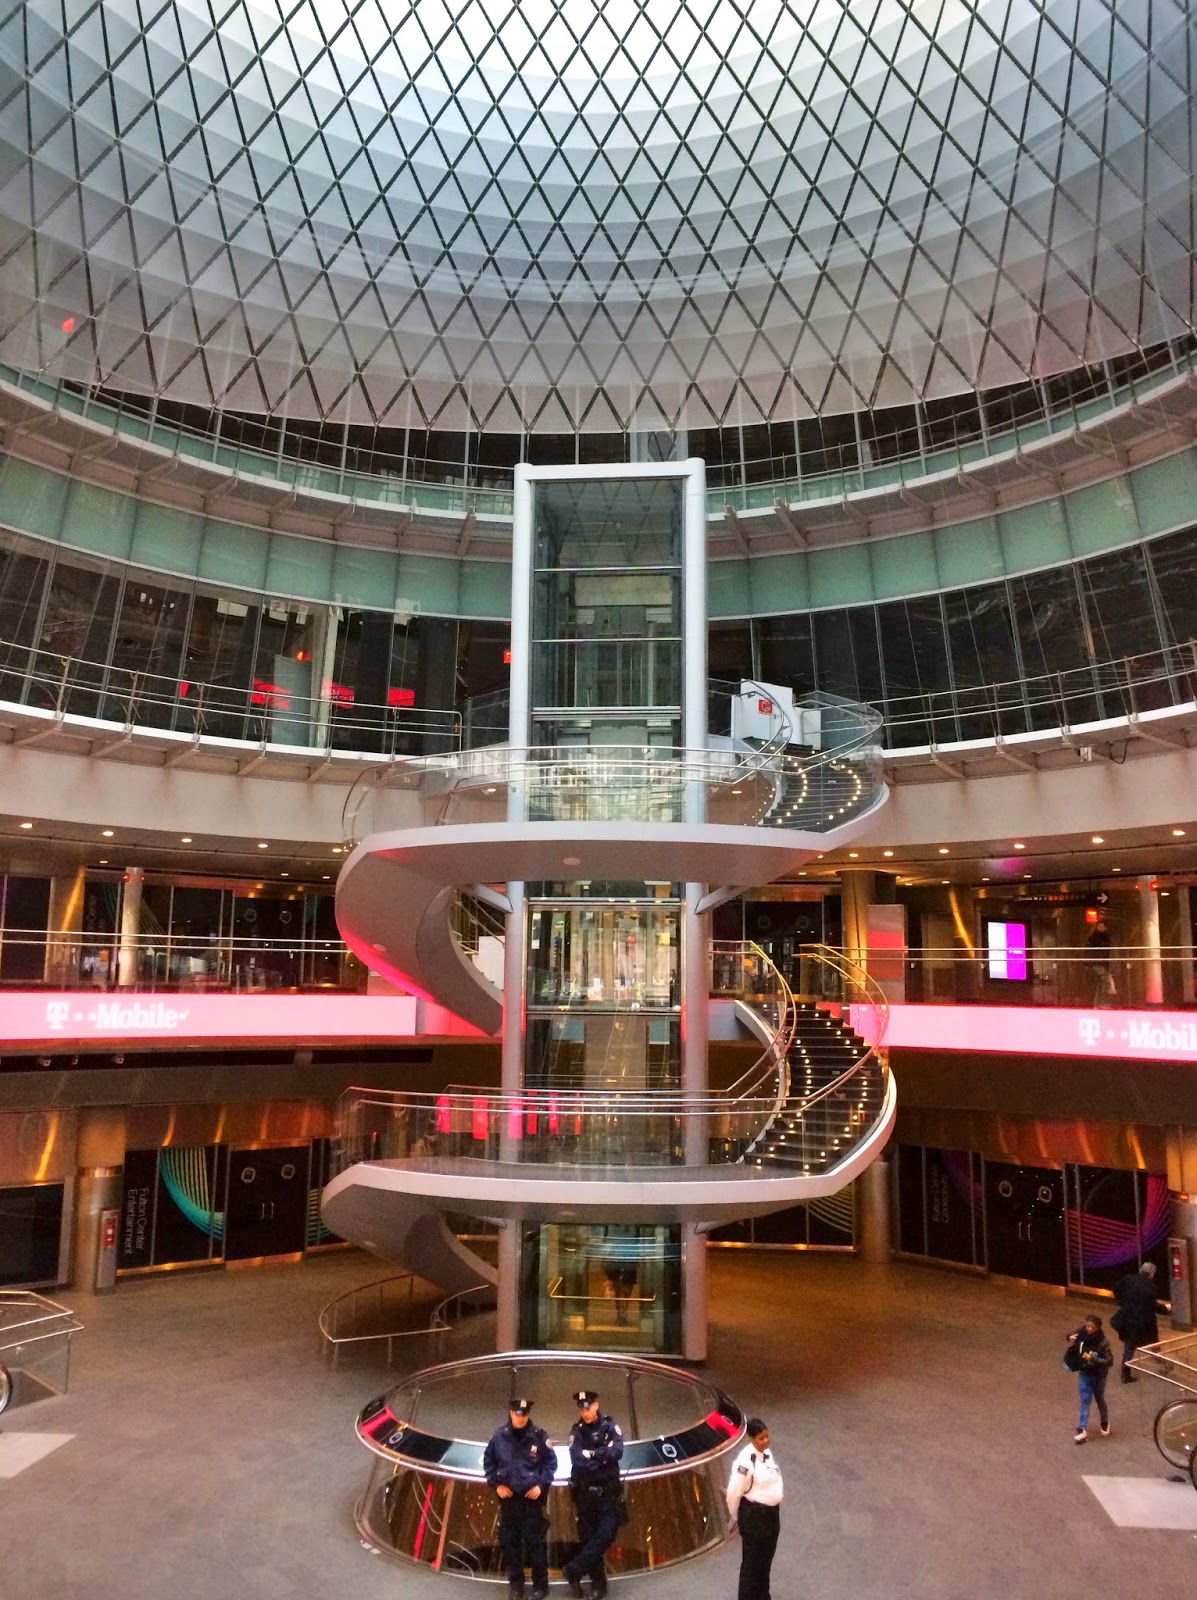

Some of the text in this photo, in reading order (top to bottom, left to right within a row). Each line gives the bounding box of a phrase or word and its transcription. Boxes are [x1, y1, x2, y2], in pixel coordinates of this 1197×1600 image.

[124, 1189, 138, 1254] Entertainment
[135, 1188, 149, 1250] Fulton Center
